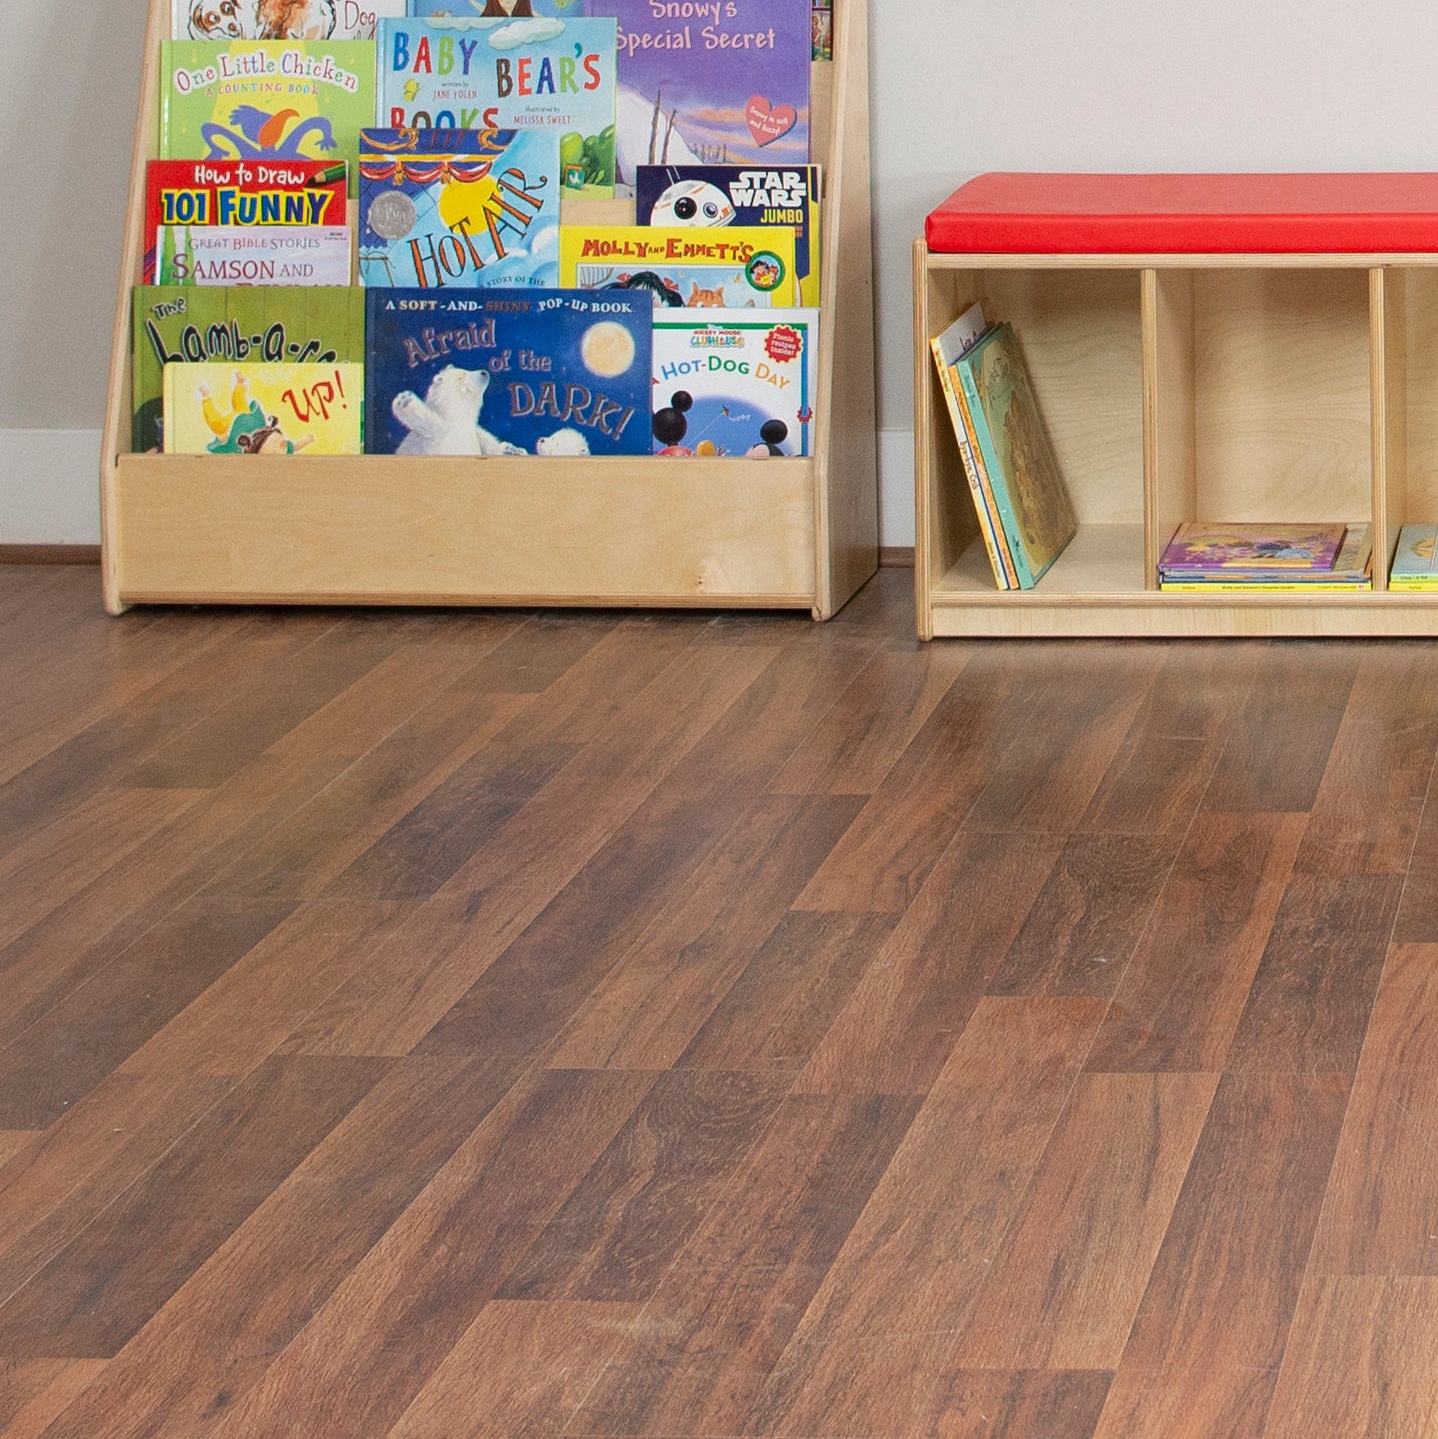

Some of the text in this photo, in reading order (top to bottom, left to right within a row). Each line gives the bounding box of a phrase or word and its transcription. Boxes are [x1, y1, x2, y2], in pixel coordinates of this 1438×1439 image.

[344, 0, 377, 40] Dog
[392, 32, 479, 76] BABY
[616, 25, 777, 57] Special Secret
[176, 51, 358, 93] One Little Chicken
[496, 41, 602, 99] BEAR'S
[205, 82, 320, 97] A COUNTING BOOK
[432, 89, 478, 101] JANE YOLEN
[513, 115, 572, 125] MELISSA SWEET
[194, 163, 305, 185] How to Draw
[729, 171, 807, 190] STAR
[163, 187, 334, 226] 101 FUNNY
[729, 188, 807, 208] WARS
[408, 167, 549, 288] HOT AIR
[760, 208, 804, 224] JUMBO
[188, 237, 230, 251] GREAT
[232, 236, 268, 250] BIBLE
[270, 236, 321, 251] STORIES
[581, 238, 649, 258] MOLLY
[171, 253, 314, 280] SAMSON AND
[385, 300, 396, 311] A
[591, 303, 633, 313] BOOK
[404, 317, 497, 367] Afraid
[489, 349, 552, 371] of the
[661, 355, 791, 389] HOT-DOG DAY
[282, 370, 348, 423] UP!
[508, 381, 635, 441] DARK!
